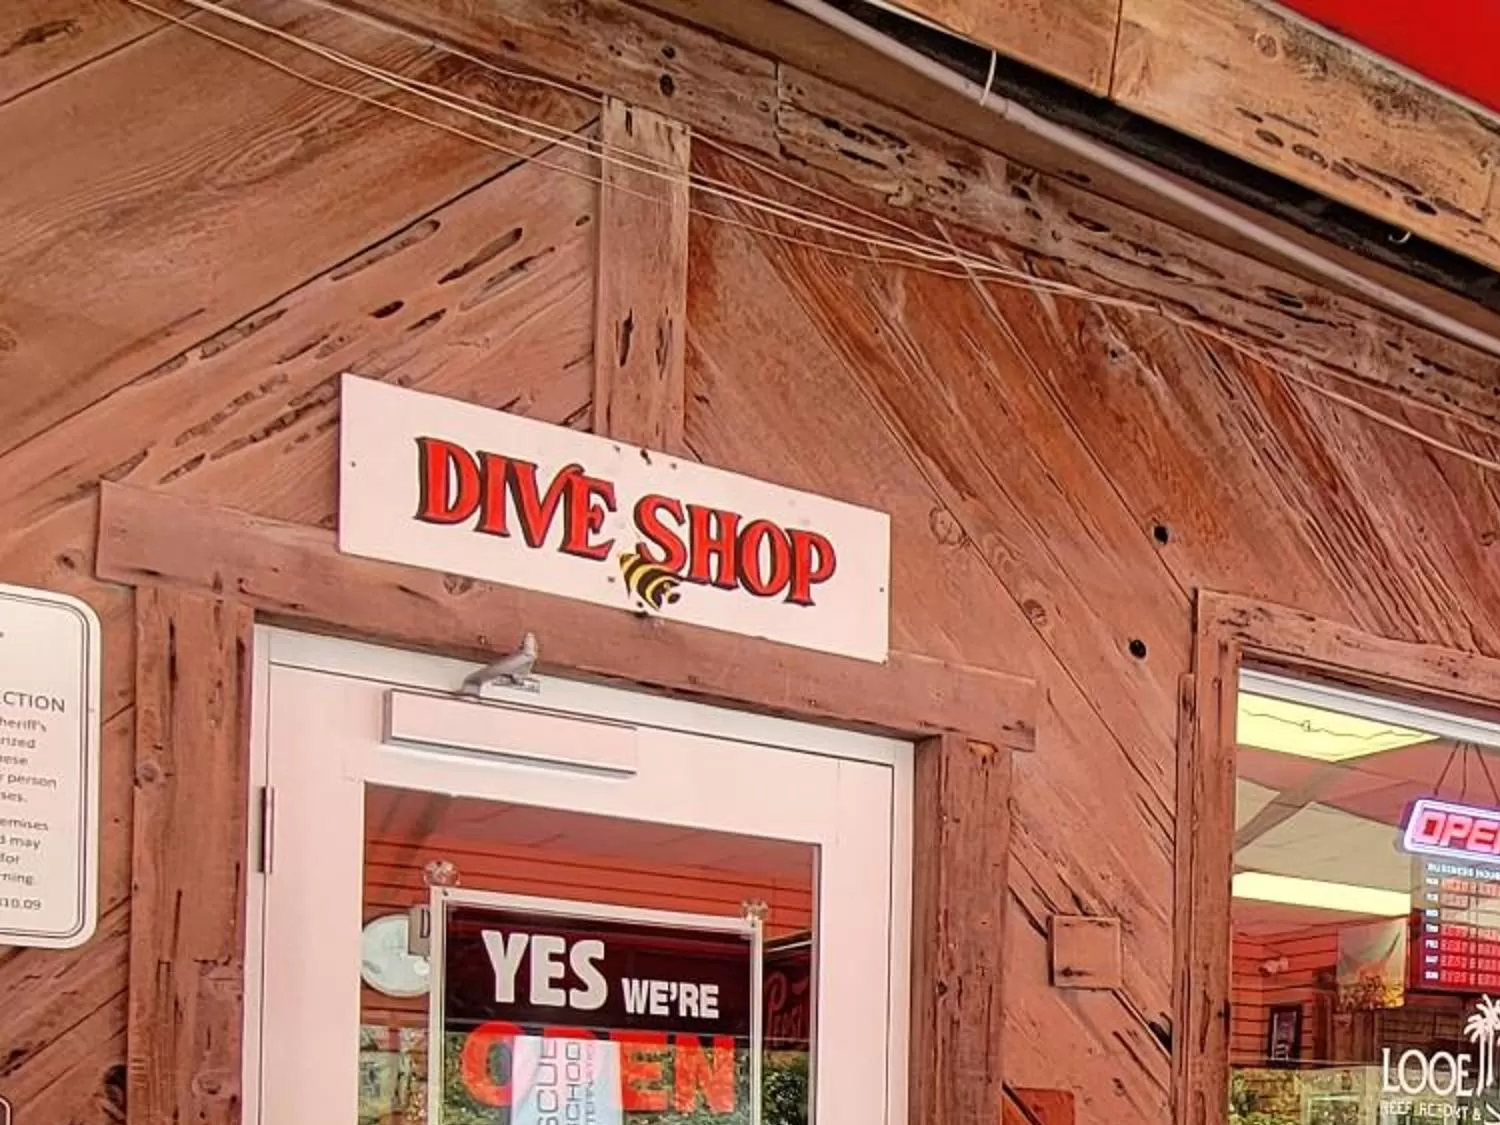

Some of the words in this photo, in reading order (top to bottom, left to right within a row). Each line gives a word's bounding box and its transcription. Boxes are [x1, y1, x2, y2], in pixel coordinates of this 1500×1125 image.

[415, 436, 618, 561] DIVE
[633, 494, 837, 607] SHOP
[0, 691, 65, 713] CTION
[8, 774, 57, 792] person
[10, 837, 41, 851] may
[481, 930, 608, 1010] YES
[622, 978, 719, 1019] WE'RE
[459, 1021, 737, 1116] OEN
[1382, 1047, 1474, 1096] LOOE
